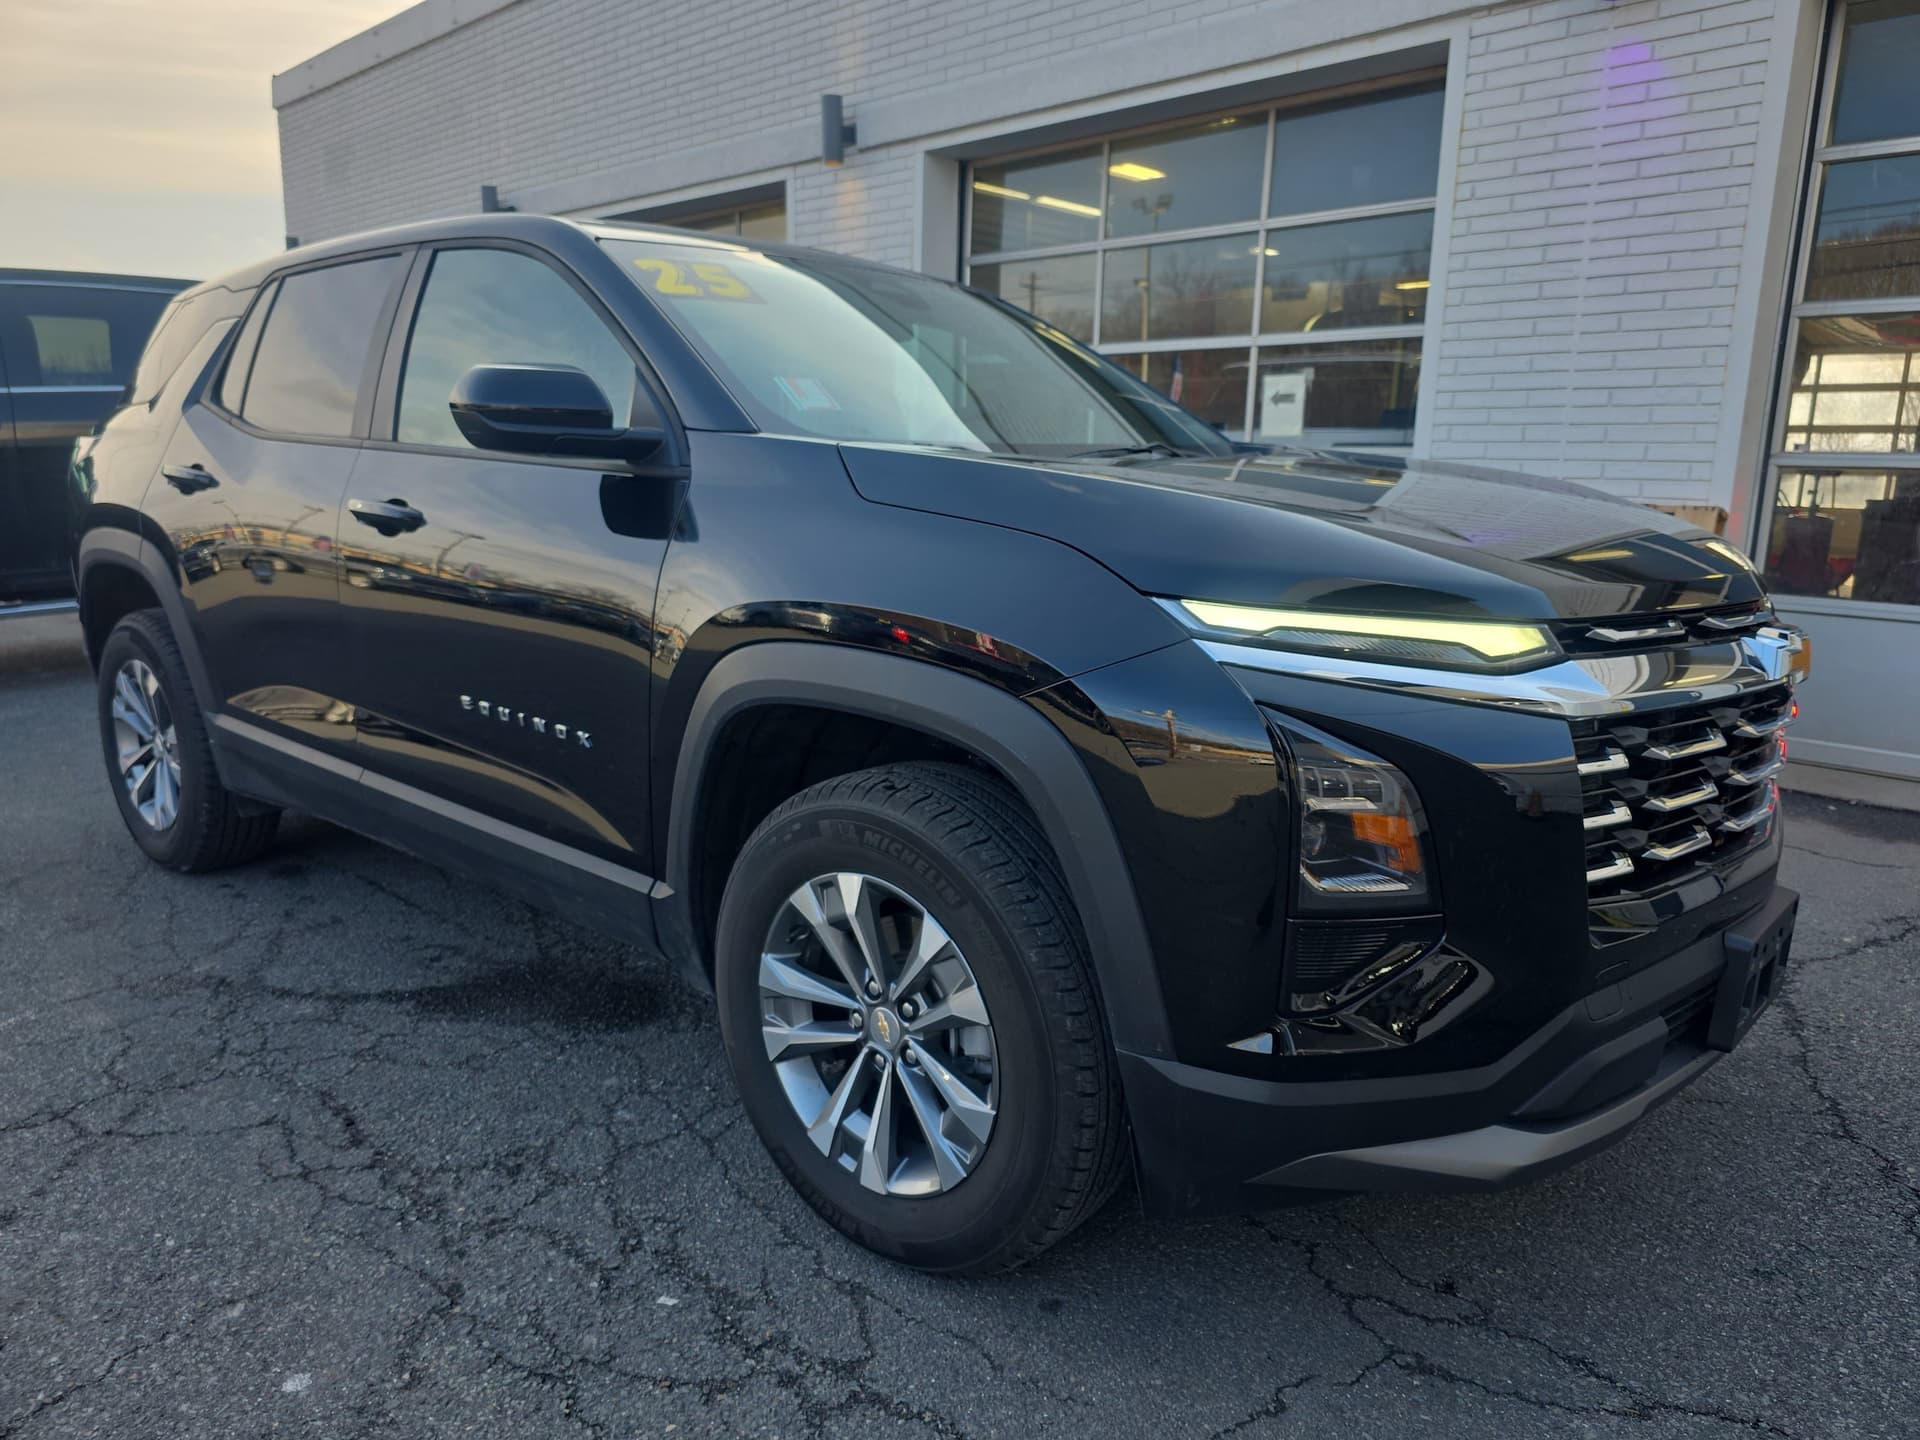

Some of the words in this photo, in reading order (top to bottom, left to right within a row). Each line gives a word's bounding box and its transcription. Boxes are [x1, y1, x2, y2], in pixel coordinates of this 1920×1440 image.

[634, 258, 752, 298] 25
[460, 694, 593, 748] EQUINOX
[863, 829, 961, 907] MICHELIN
